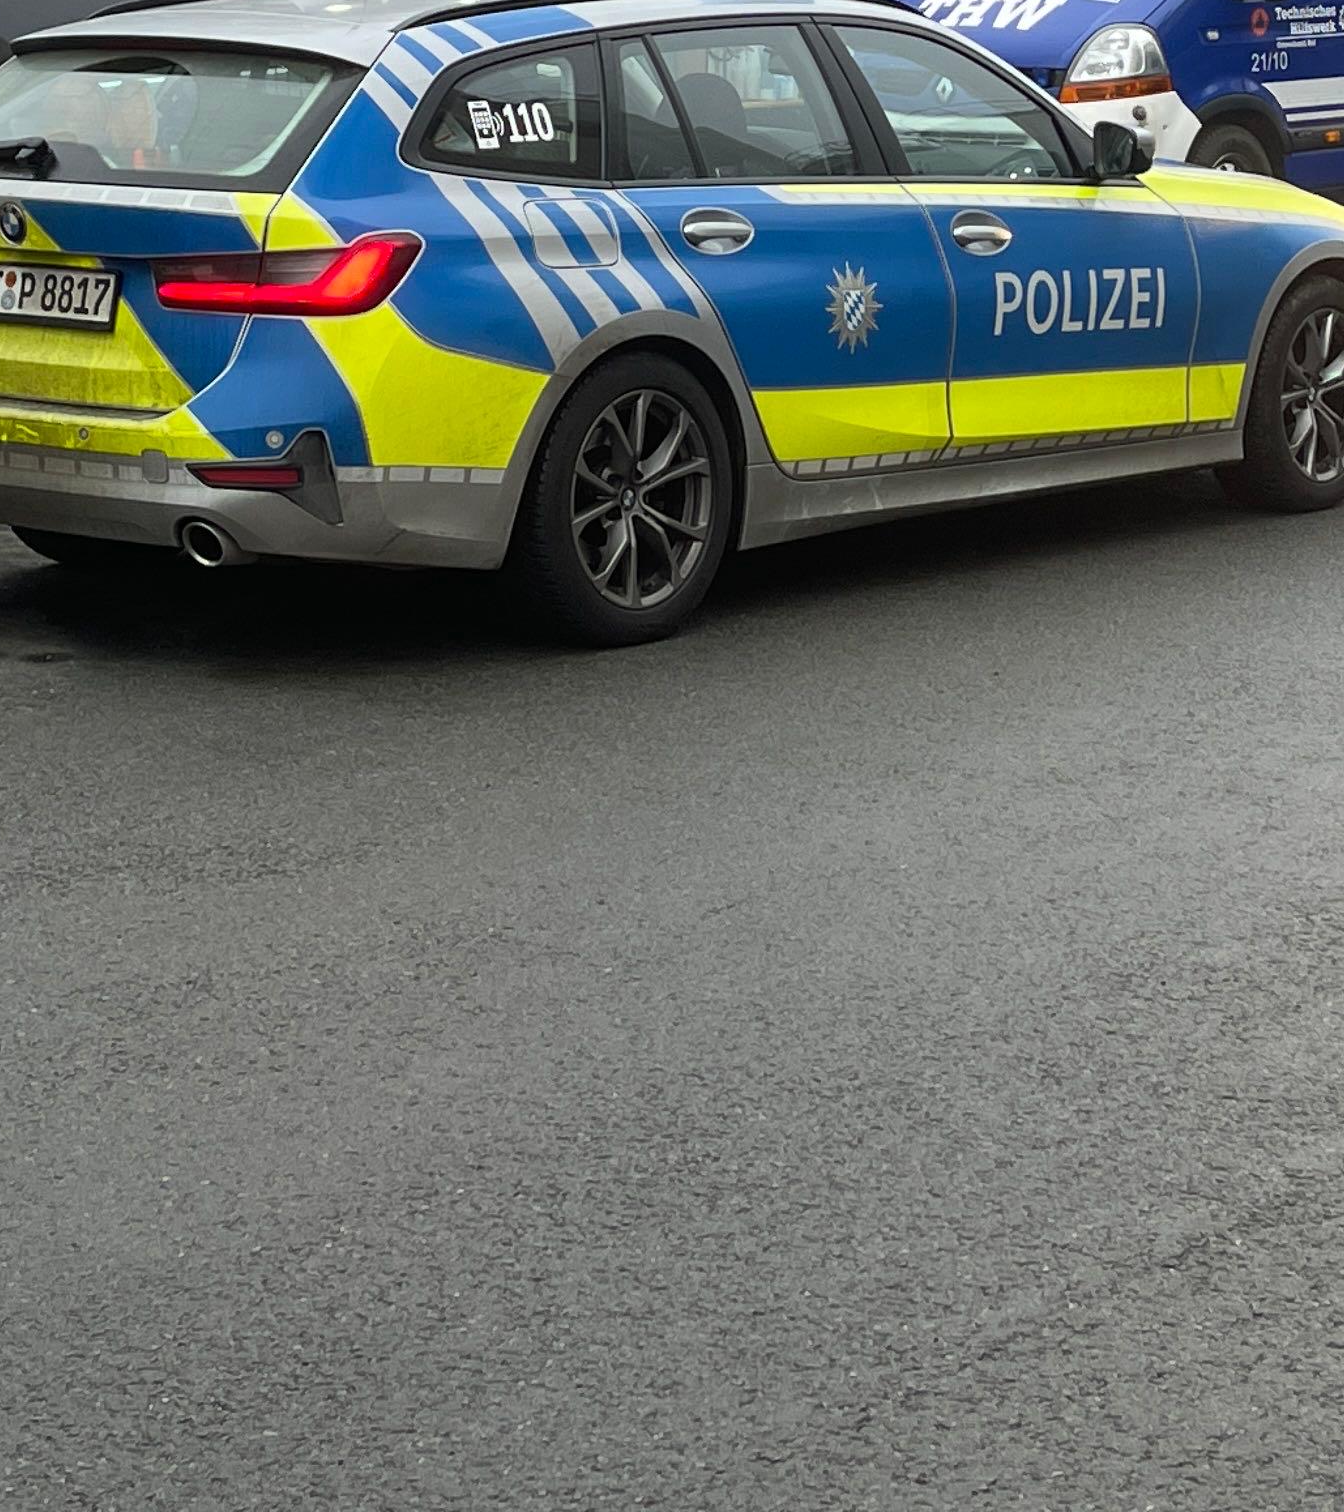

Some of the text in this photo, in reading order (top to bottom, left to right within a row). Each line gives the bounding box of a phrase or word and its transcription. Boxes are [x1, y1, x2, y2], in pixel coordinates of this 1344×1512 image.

[1250, 50, 1289, 73] 21/10
[502, 102, 555, 143] 110
[993, 266, 1166, 337] POLIZEI
